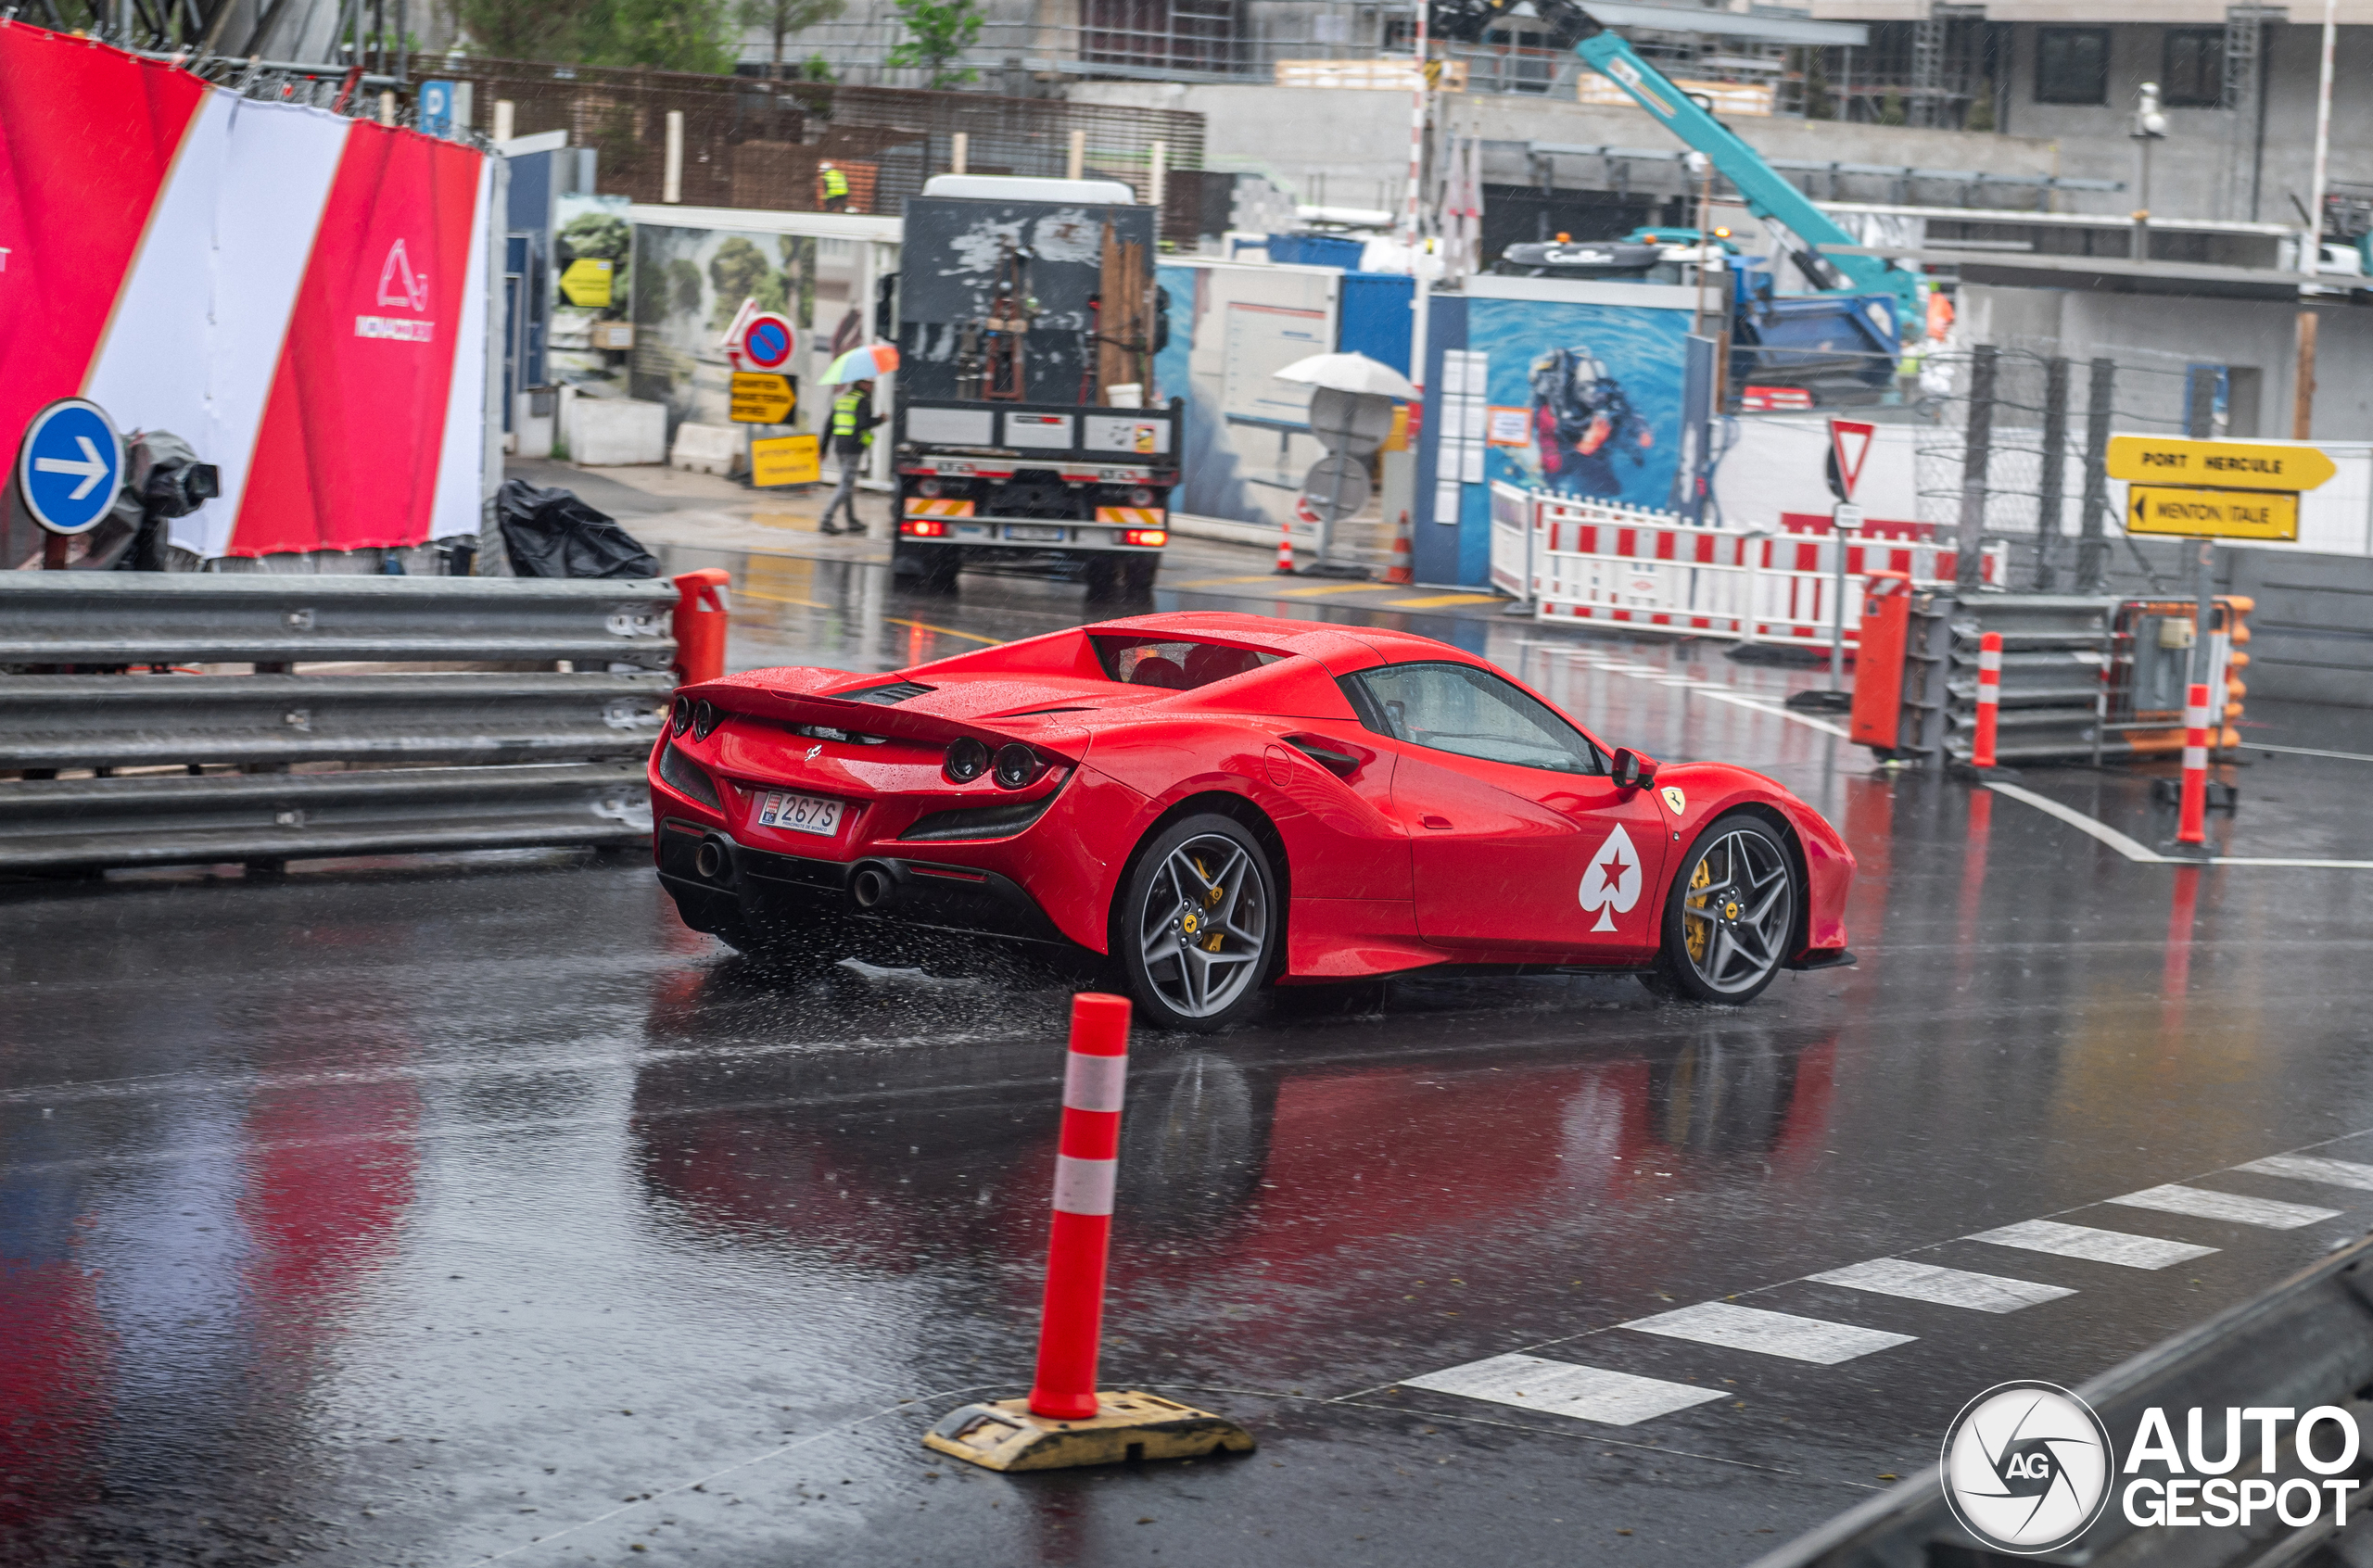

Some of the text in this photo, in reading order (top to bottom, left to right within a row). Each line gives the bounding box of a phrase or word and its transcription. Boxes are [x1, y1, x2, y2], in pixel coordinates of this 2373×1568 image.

[2141, 452, 2283, 474] PORT HERCULE
[2157, 502, 2223, 522] MENTON
[781, 796, 835, 827] 267S
